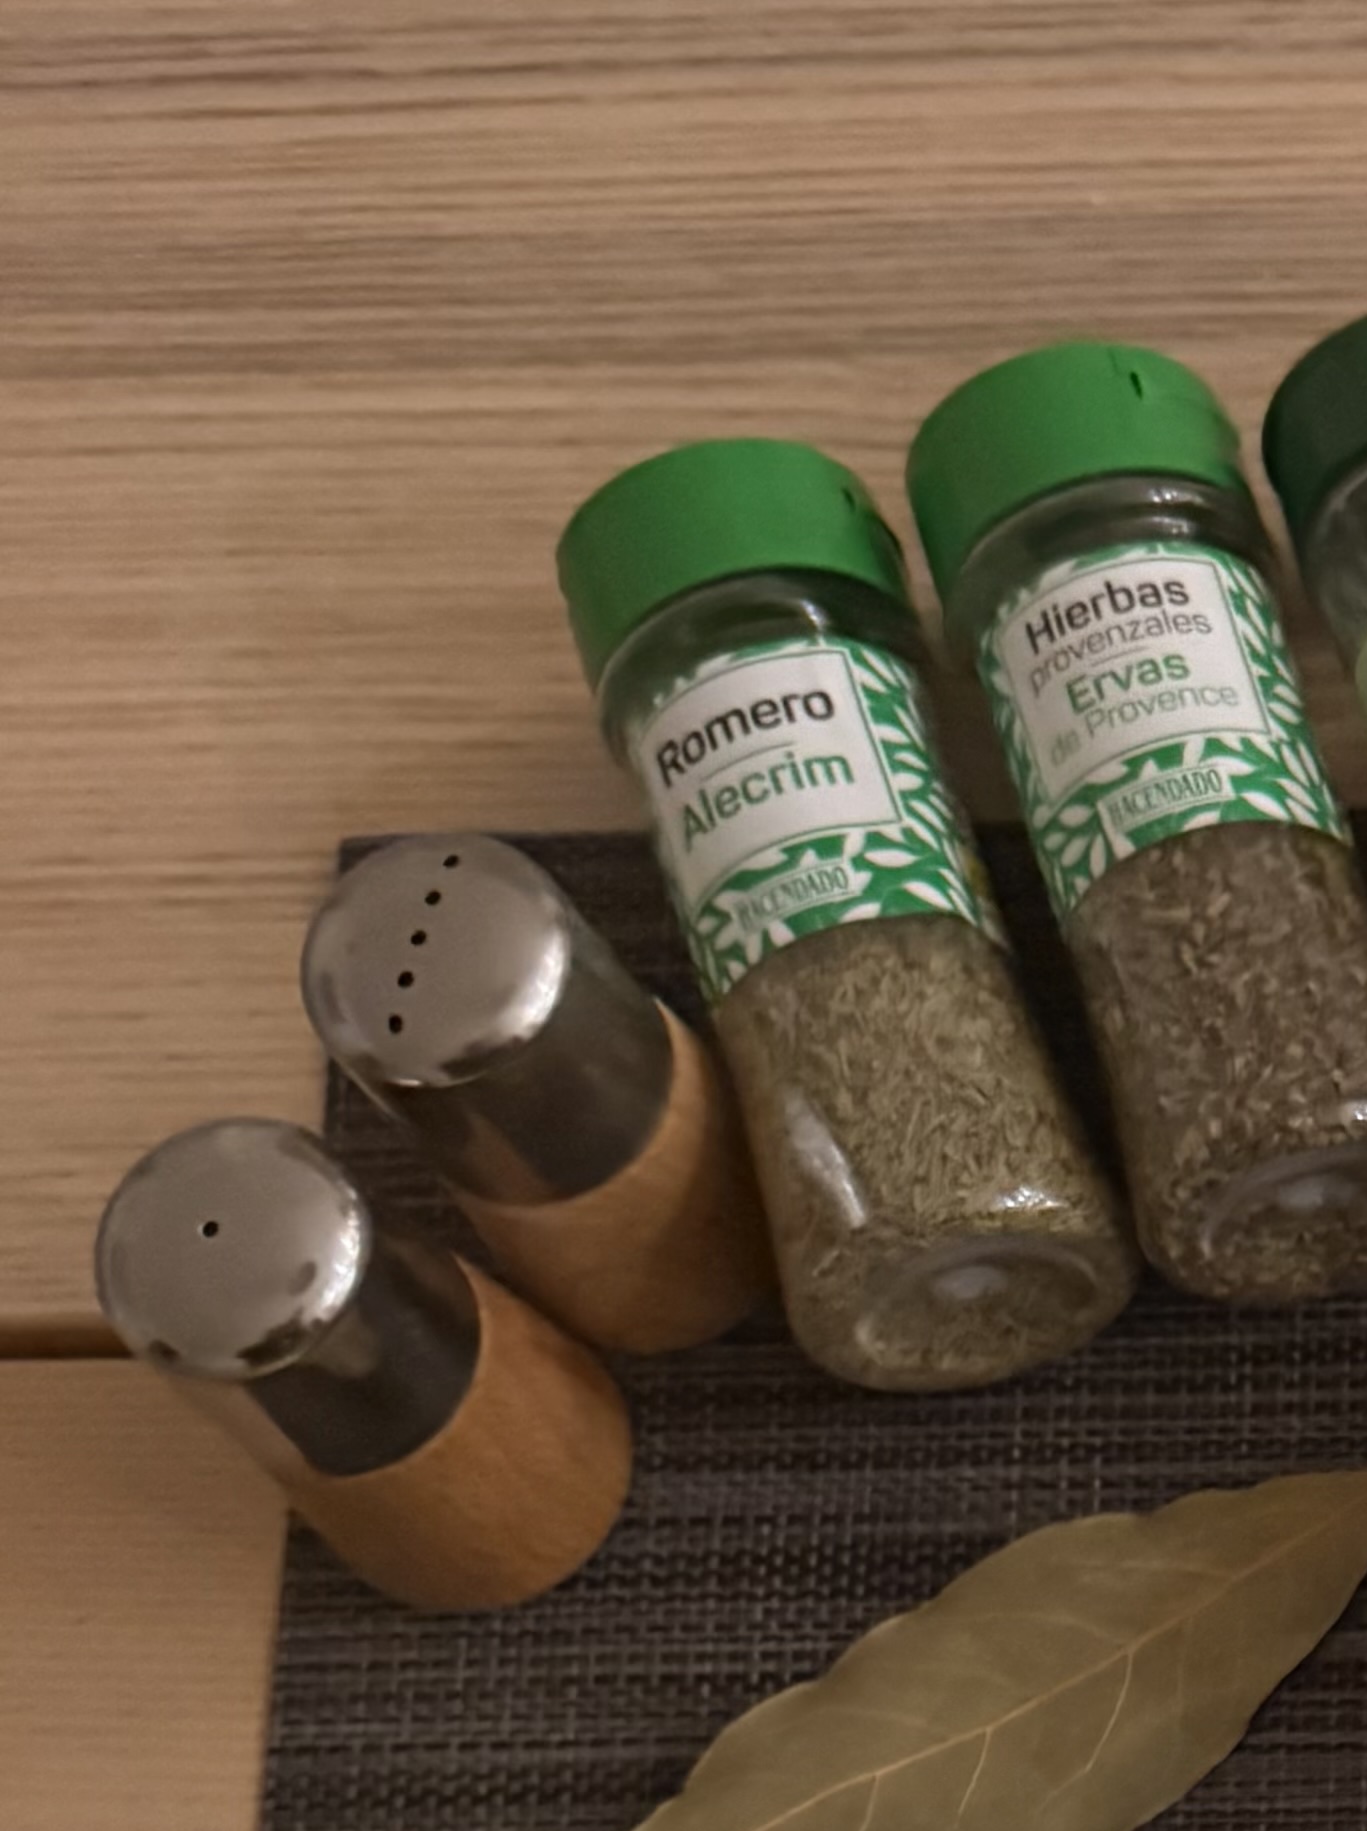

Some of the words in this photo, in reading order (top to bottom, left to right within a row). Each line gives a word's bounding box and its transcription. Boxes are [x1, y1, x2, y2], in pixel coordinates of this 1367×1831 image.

[1025, 580, 1190, 655] Hierbas
[1030, 609, 1213, 696] provenzales
[1050, 733, 1079, 765] de
[1086, 682, 1240, 738] Provence
[1065, 653, 1191, 713] Ervas
[656, 691, 835, 788] Romero
[680, 752, 855, 853] Alecrim
[1108, 769, 1223, 824] HACENDADO
